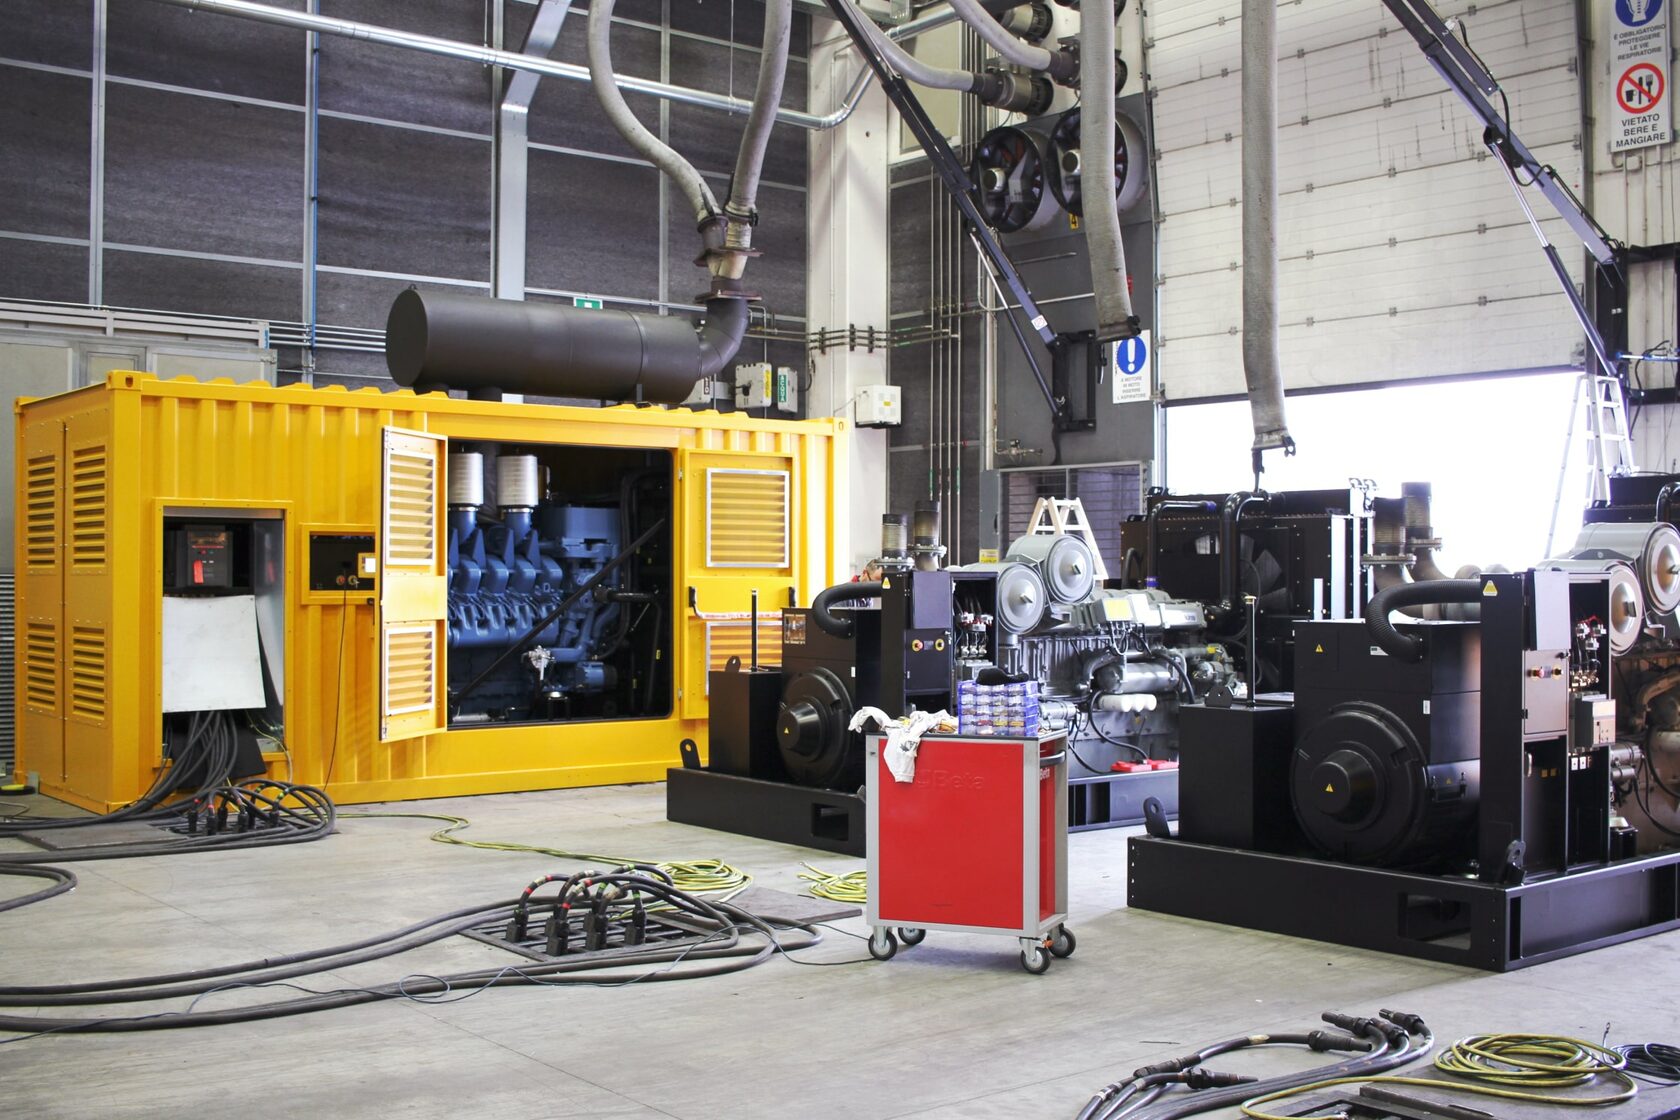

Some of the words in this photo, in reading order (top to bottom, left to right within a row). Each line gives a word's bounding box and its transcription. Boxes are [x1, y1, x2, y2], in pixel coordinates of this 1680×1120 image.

[1621, 113, 1660, 126] VIETATO
[1624, 125, 1649, 136] BERE
[1651, 123, 1658, 131] E
[1616, 132, 1666, 147] MANGIARE
